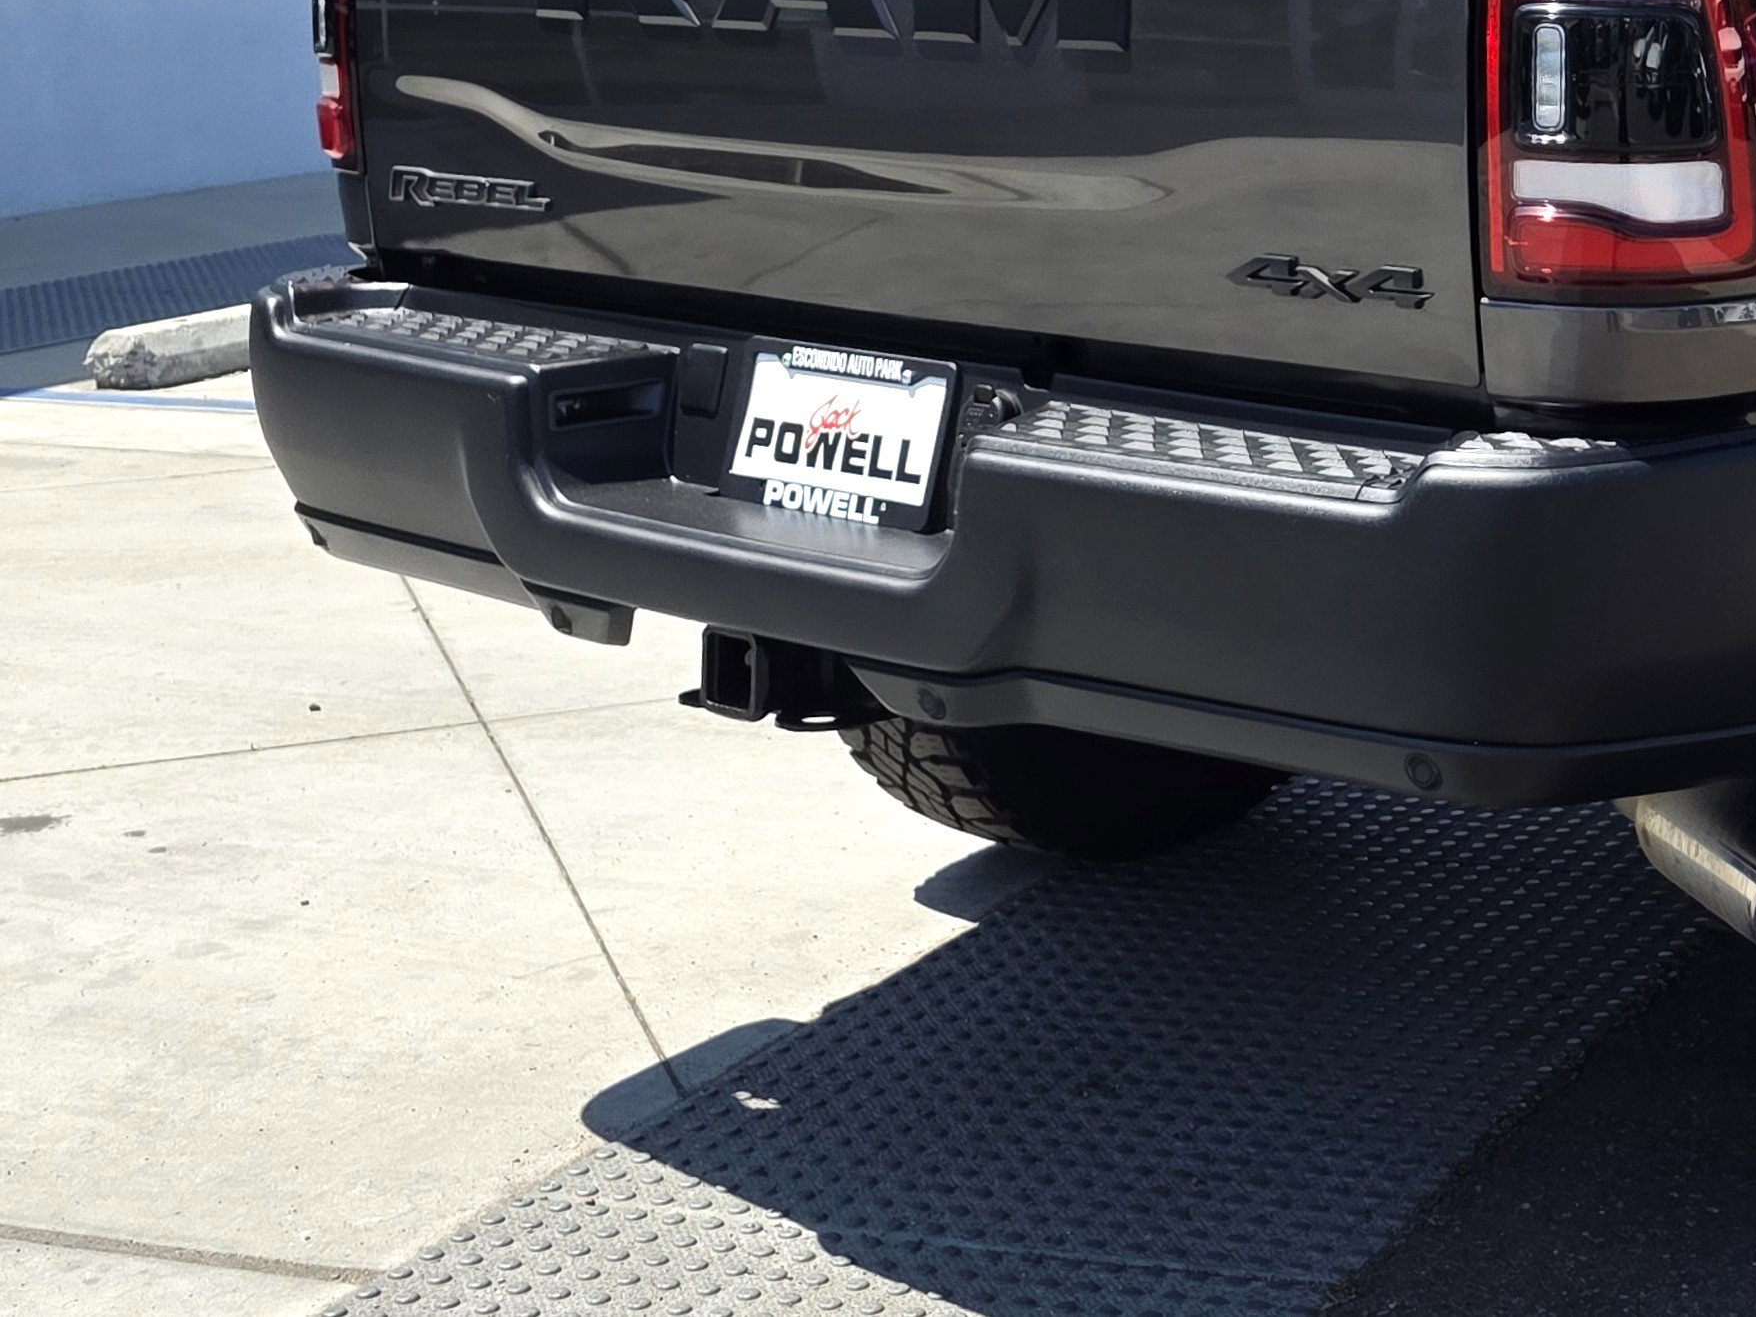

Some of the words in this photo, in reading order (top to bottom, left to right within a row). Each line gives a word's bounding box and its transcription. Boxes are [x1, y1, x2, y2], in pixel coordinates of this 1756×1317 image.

[388, 164, 552, 212] REBEL
[791, 345, 848, 373] ESCONDIDO
[847, 353, 875, 378] AUTO
[873, 357, 904, 382] PARK
[744, 416, 922, 485] POWELL
[763, 479, 880, 525] POWELL
